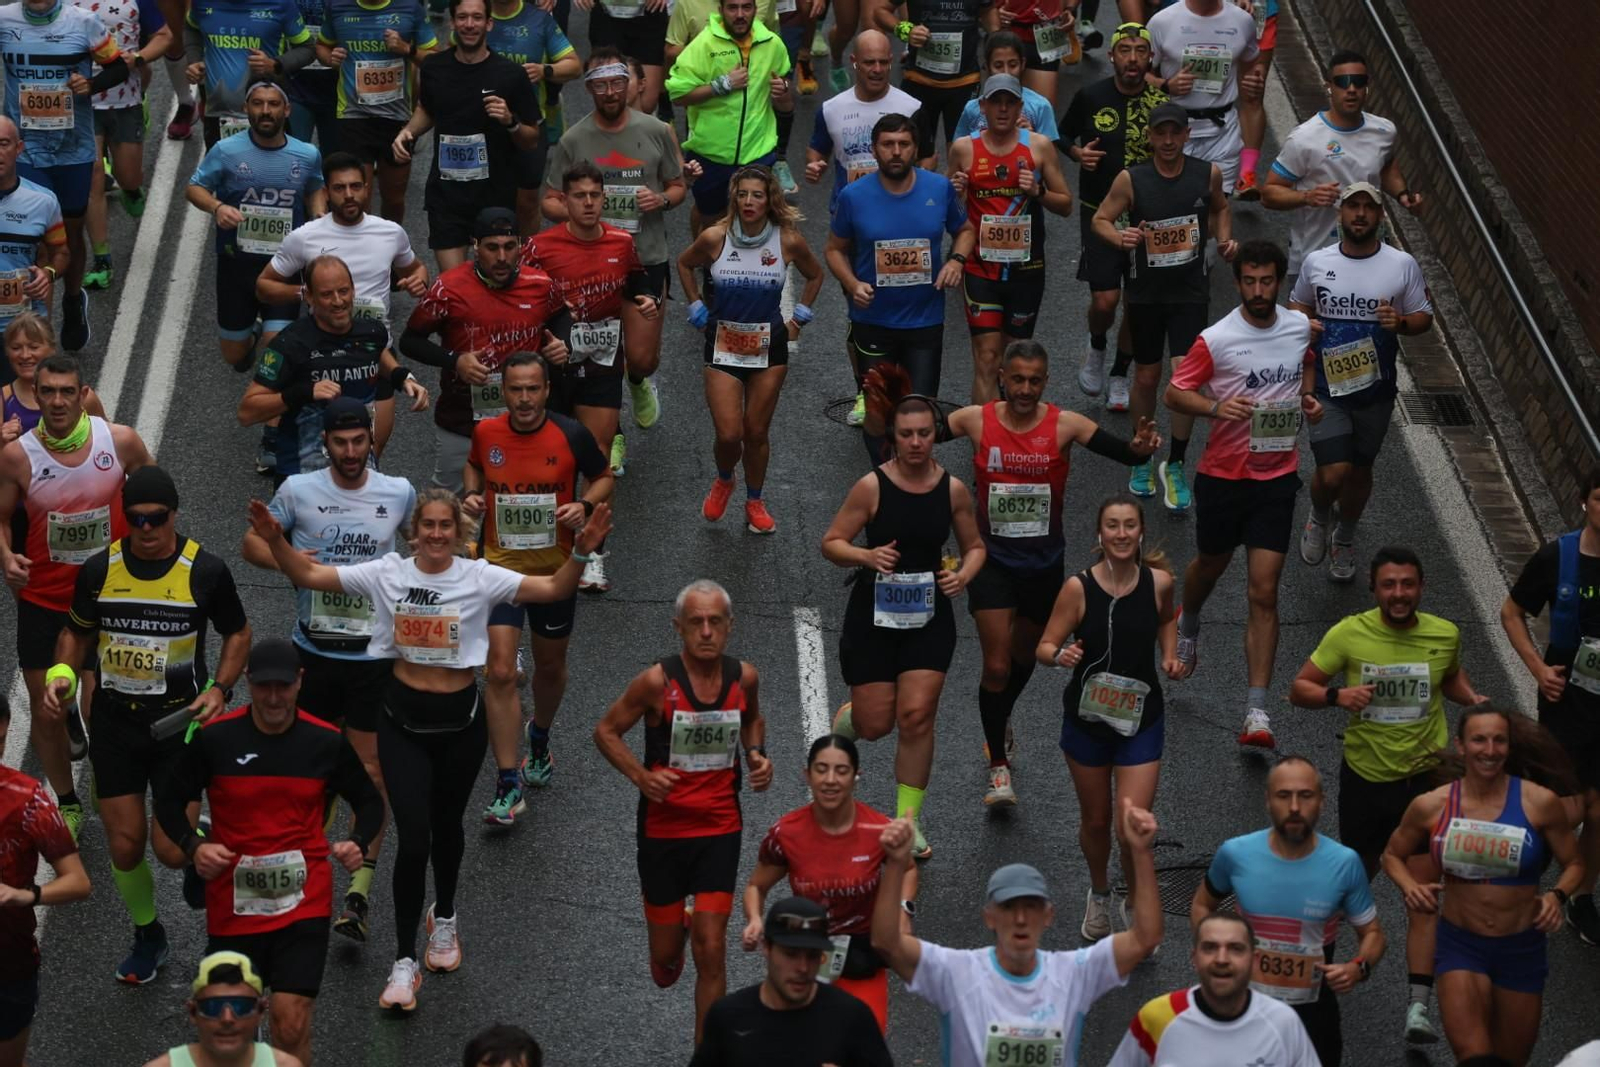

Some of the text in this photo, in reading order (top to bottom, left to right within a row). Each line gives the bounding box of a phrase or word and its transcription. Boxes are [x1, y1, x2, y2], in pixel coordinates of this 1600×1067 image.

[208, 35, 261, 49] TUSSAM
[345, 40, 388, 53] TUSSA
[929, 43, 950, 56] 835
[16, 69, 72, 80] CAUDET
[1190, 59, 1219, 74] 7201
[363, 71, 394, 86] 6333
[28, 95, 61, 110] 6304
[447, 147, 475, 162] 1962
[241, 187, 297, 206] ADS
[243, 215, 284, 235] 10169
[988, 227, 1020, 243] 5910
[1153, 231, 1187, 247] 5828
[884, 250, 918, 267] 3622
[3, 282, 18, 297] 81
[1319, 305, 1366, 317] UNNING
[576, 331, 613, 347] 16055
[1328, 351, 1370, 372] 13303
[310, 368, 340, 382] SAN
[1259, 363, 1301, 388] Salud
[481, 387, 500, 402] 68
[1260, 413, 1294, 430] 7337
[996, 498, 1036, 515] 8632
[504, 508, 542, 526] 8190
[57, 523, 98, 543] 7997
[335, 545, 377, 556] DESTINO
[404, 587, 443, 605] NIKE
[884, 586, 922, 605] 3000
[402, 618, 445, 638] 3974
[104, 647, 154, 672] 11763
[1090, 686, 1137, 709] 10279
[683, 726, 724, 746] 7564
[1452, 833, 1511, 860] 10018
[245, 868, 291, 890] 8815
[1260, 952, 1306, 978] 6331
[997, 1041, 1047, 1066] 9168
